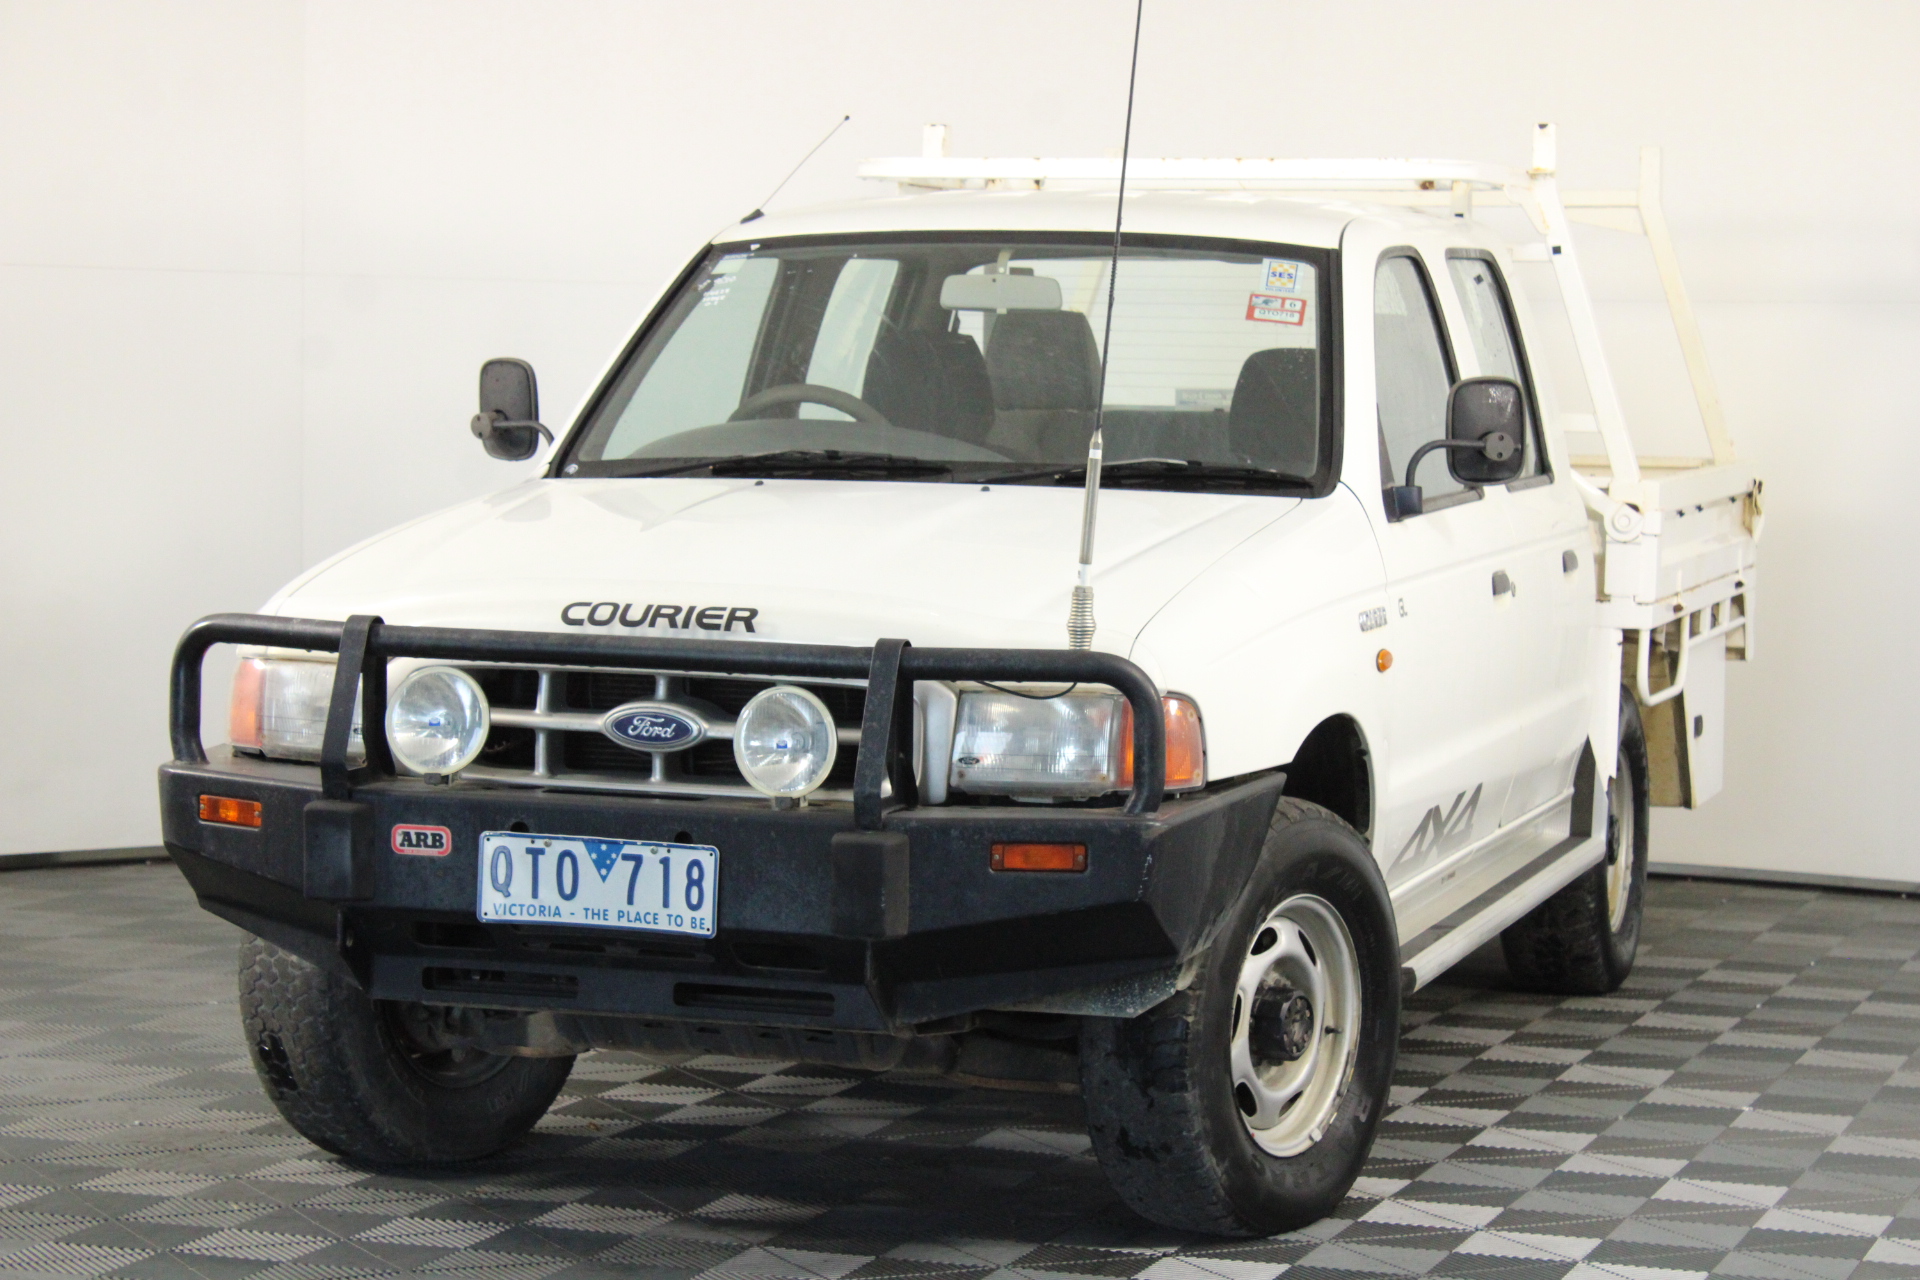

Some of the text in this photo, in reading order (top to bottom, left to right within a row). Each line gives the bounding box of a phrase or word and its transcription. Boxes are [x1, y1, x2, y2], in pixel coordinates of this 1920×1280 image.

[1270, 271, 1294, 279] SES
[1258, 309, 1295, 318] QTO718
[1289, 301, 1296, 309] 6
[561, 601, 759, 633] COURIER
[627, 715, 676, 739] Ford
[399, 830, 445, 849] ARB
[620, 852, 705, 912] 718
[493, 902, 562, 918] VICTORIA
[583, 907, 609, 921] THE
[617, 909, 659, 926] PLACE
[666, 913, 684, 928] TO
[690, 916, 706, 930] BE
